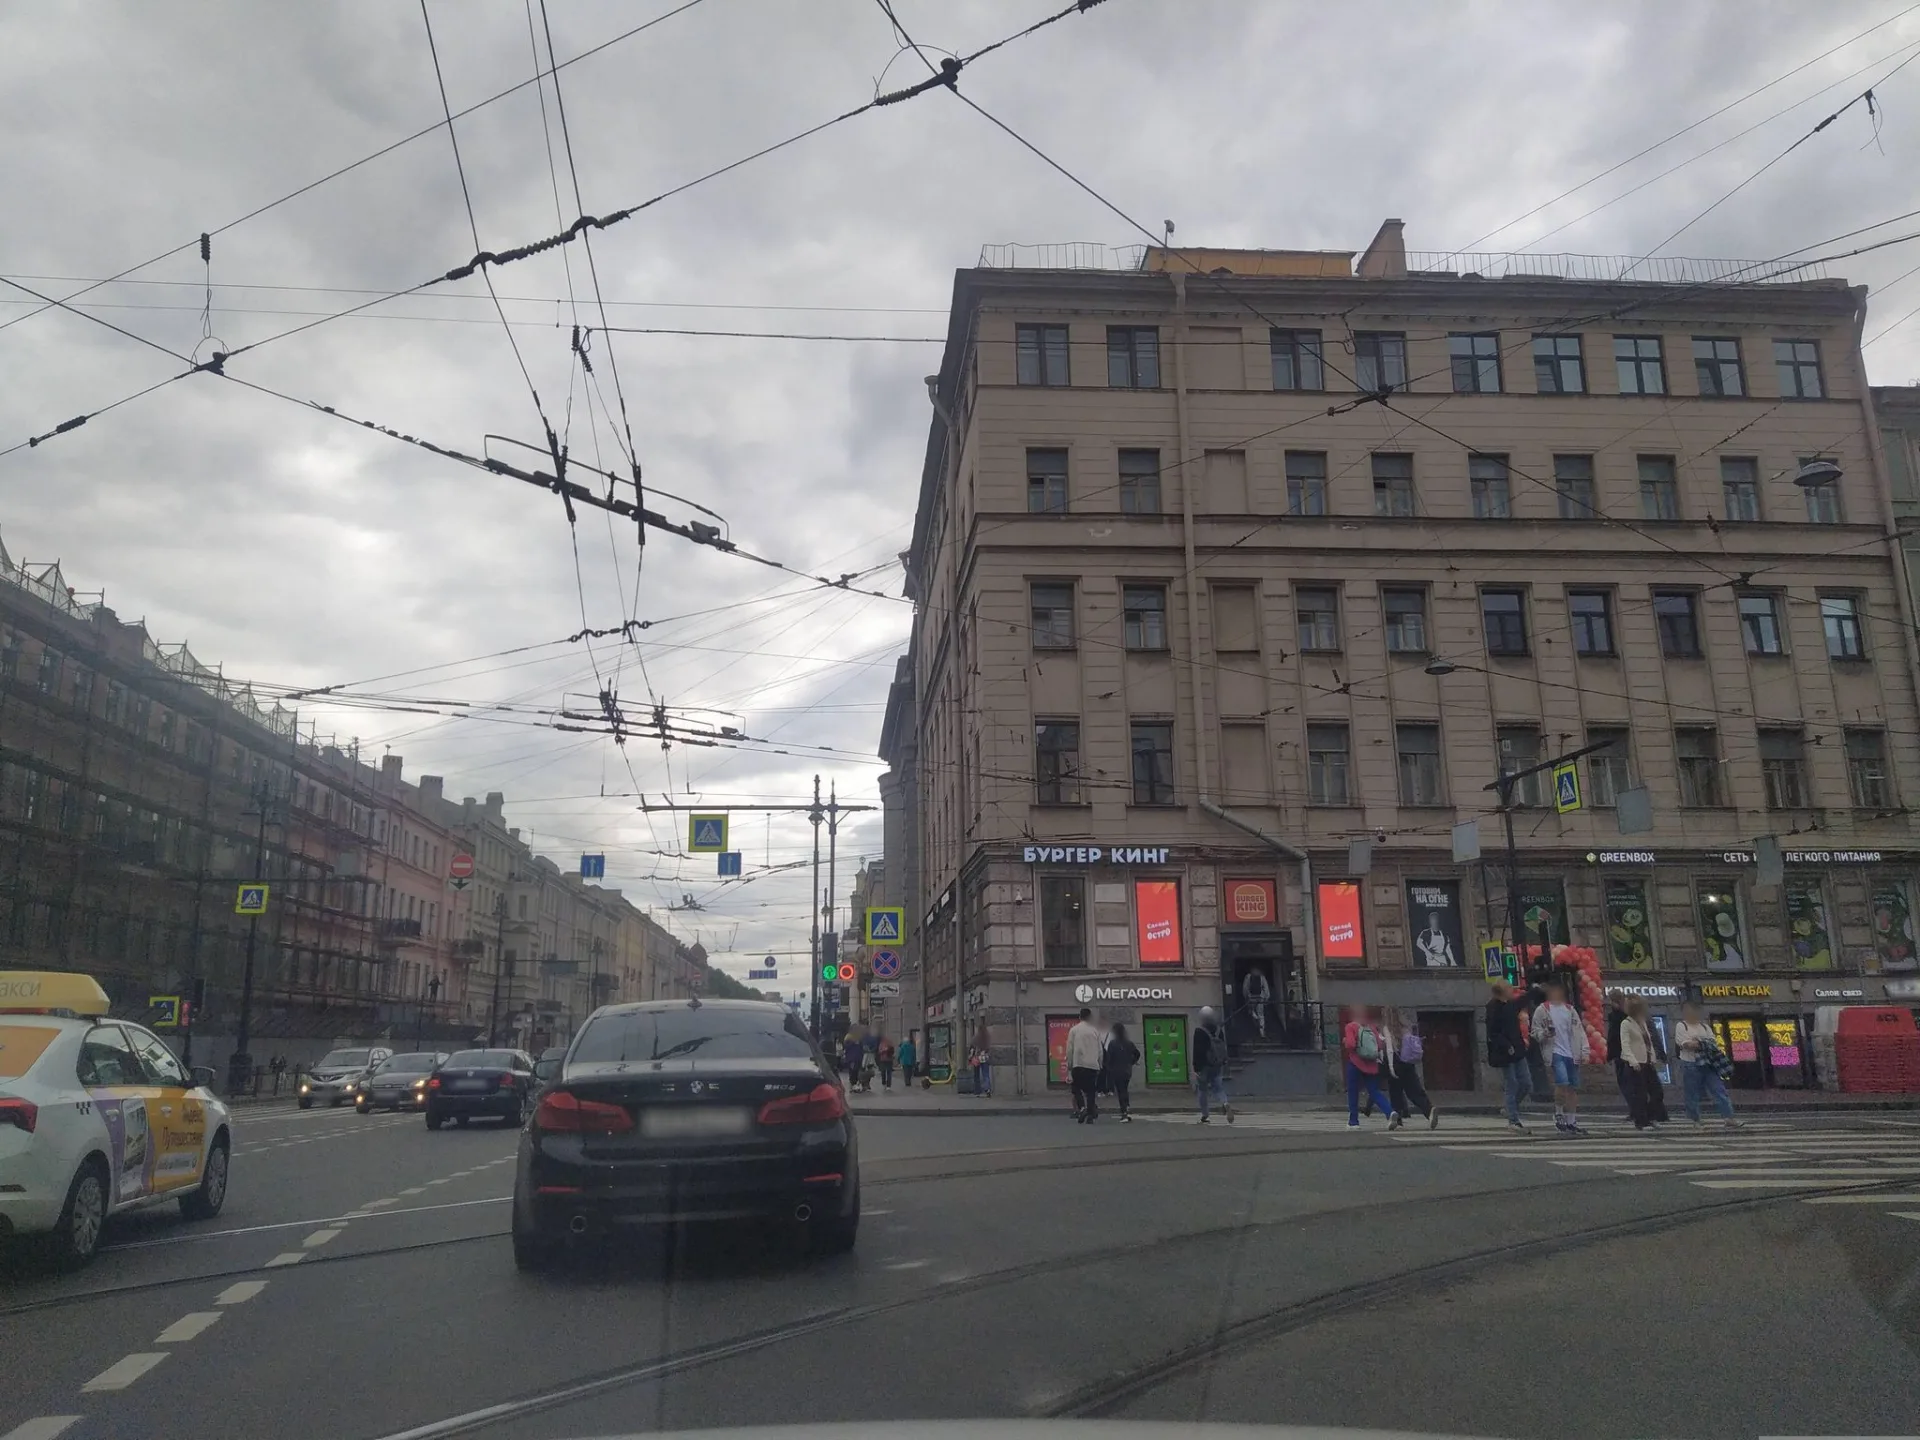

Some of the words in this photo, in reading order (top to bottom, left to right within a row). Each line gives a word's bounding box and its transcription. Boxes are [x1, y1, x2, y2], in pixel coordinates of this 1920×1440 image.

[1024, 847, 1101, 863] БУРГЕР
[1111, 848, 1169, 863] КИНГ
[1600, 852, 1655, 863] GREENBOX
[1723, 852, 1749, 863] СЕТЬ
[1786, 852, 1830, 862] ЛЕГКОГО
[1834, 852, 1881, 862] ПИТАНИЯ
[1416, 894, 1427, 903] НА
[1428, 894, 1449, 904] ОГНЕ
[1237, 902, 1265, 911] KING
[1147, 927, 1171, 940] ОСТРО
[1330, 930, 1353, 942] ОСТРО
[0, 981, 41, 997] акси
[1701, 985, 1771, 997] КИНГ-ТАБАК
[1815, 988, 1839, 997] Салон
[1730, 1029, 1750, 1042] 24
